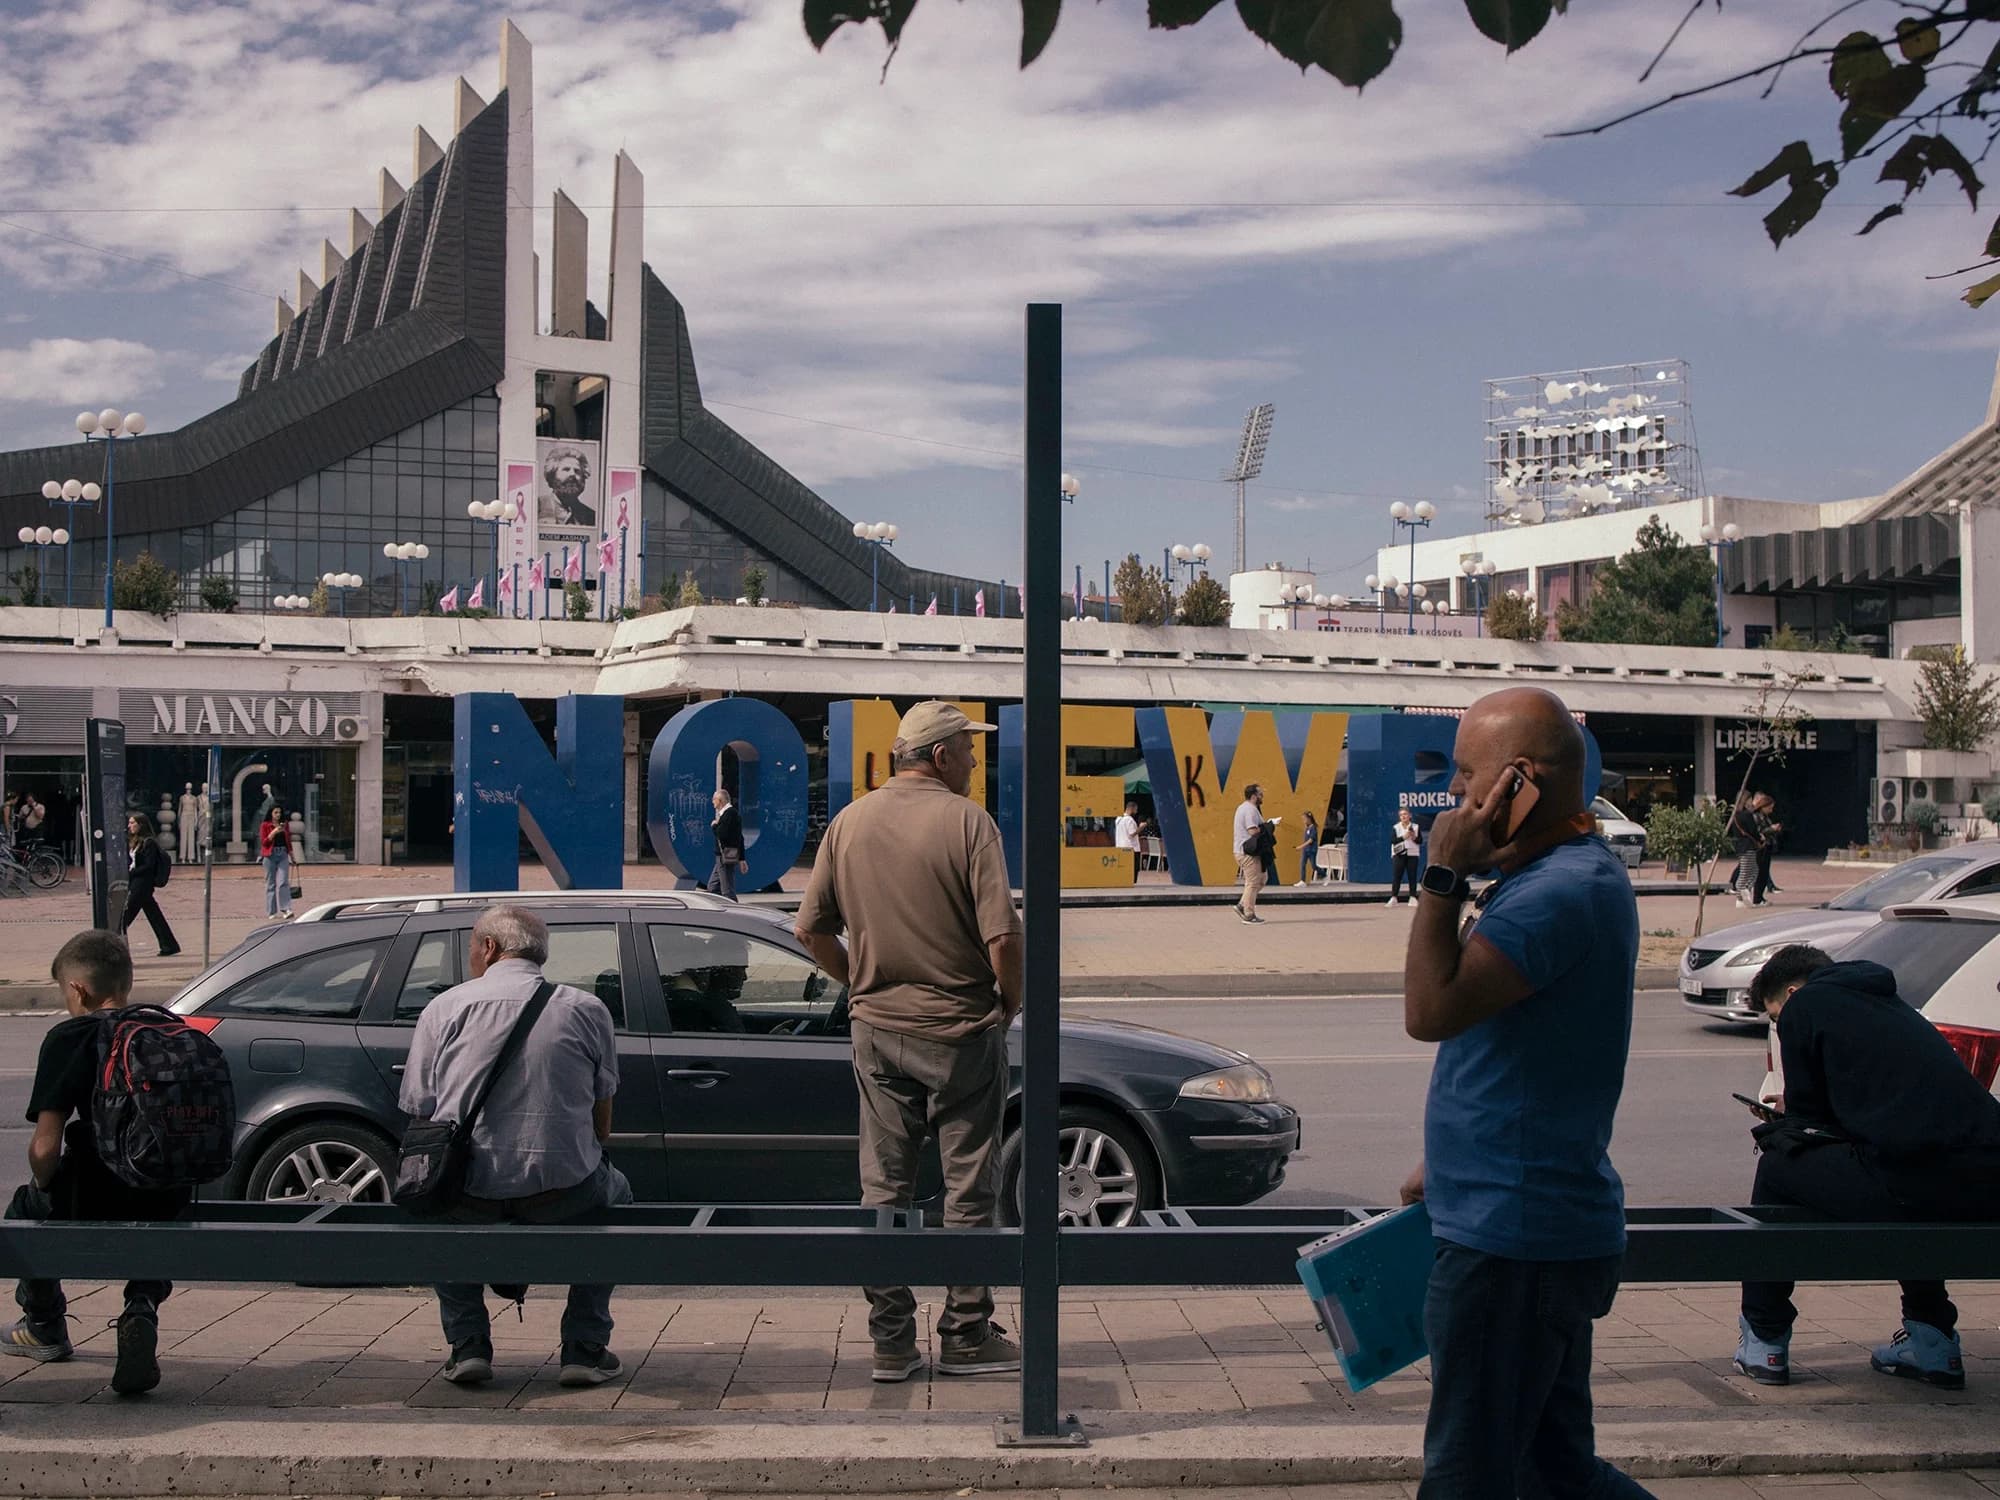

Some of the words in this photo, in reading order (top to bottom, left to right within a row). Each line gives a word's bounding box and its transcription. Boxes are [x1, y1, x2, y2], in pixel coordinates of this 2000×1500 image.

[1374, 627, 1418, 636] KOMBËTR
[152, 695, 328, 737] MANGO
[1716, 729, 1817, 750] LIFESTYLE
[453, 691, 809, 893] NO
[1184, 753, 1206, 808] K
[1398, 791, 1456, 808] BROKEN
